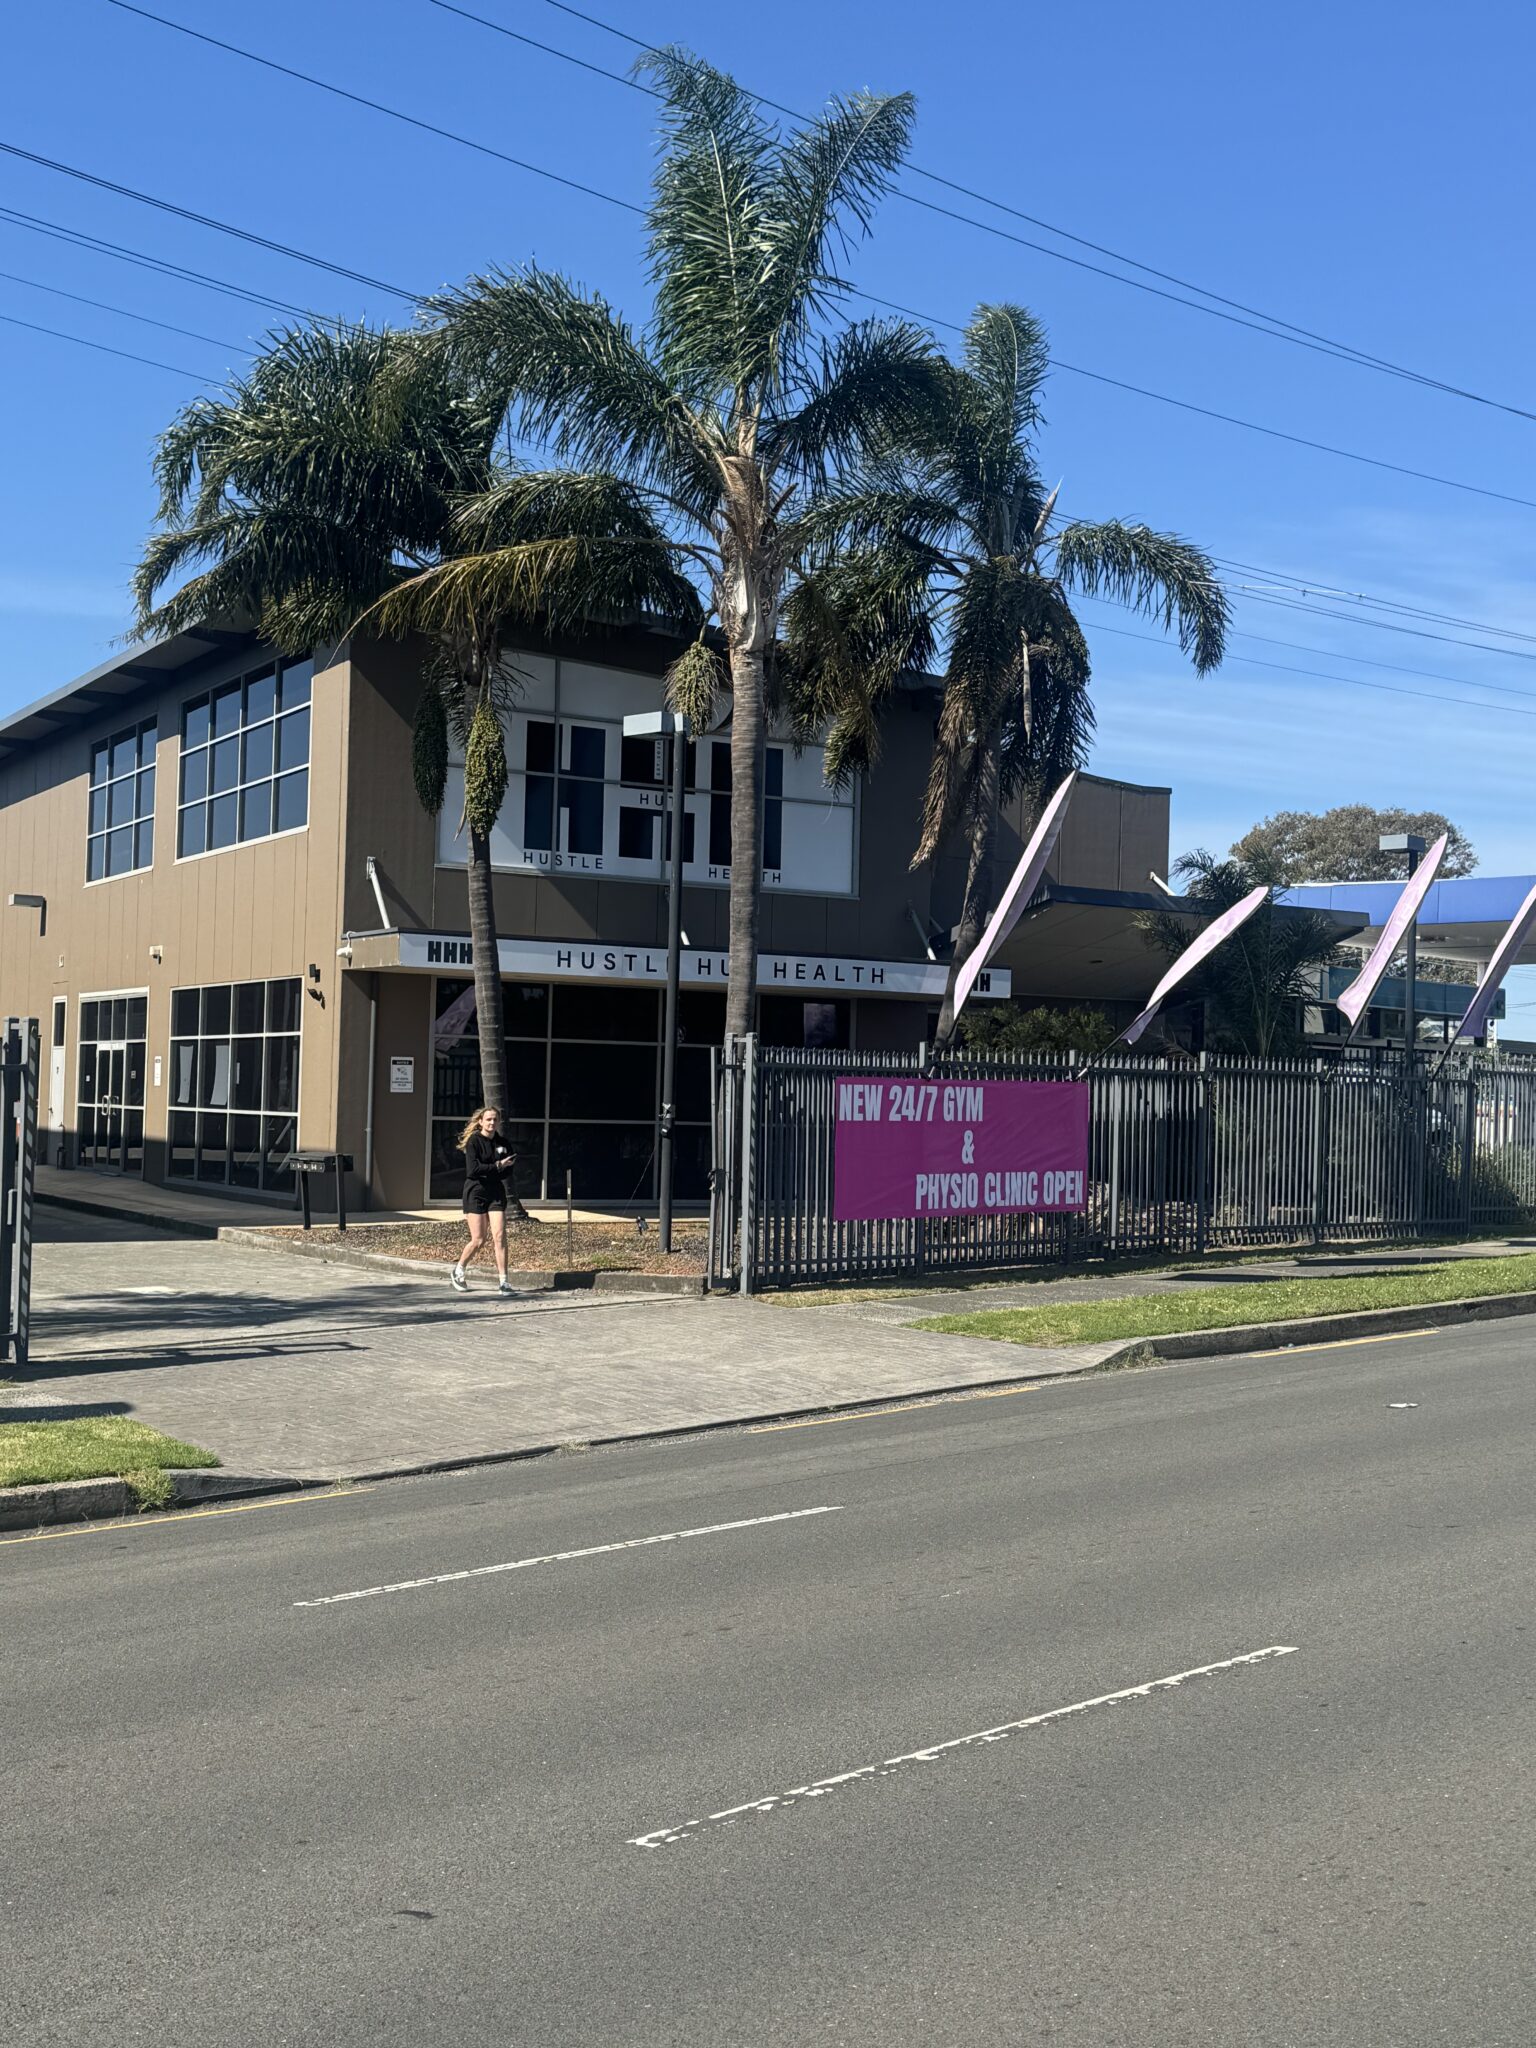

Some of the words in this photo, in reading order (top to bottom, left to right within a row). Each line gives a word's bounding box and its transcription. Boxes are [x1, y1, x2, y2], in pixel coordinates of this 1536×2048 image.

[524, 851, 603, 870] HUSTLE
[708, 867, 781, 883] HETH
[427, 940, 473, 965] HHH
[556, 949, 670, 974] HUSTL
[697, 957, 730, 977] HU
[773, 961, 886, 984] HEALTH
[838, 1084, 884, 1121] NEW
[888, 1085, 938, 1122] 24/7
[943, 1086, 984, 1122] GYM
[961, 1130, 975, 1164] &
[915, 1172, 979, 1210] PHYSIO
[984, 1171, 1038, 1207] CLINIC
[1043, 1170, 1083, 1205] OPEN
